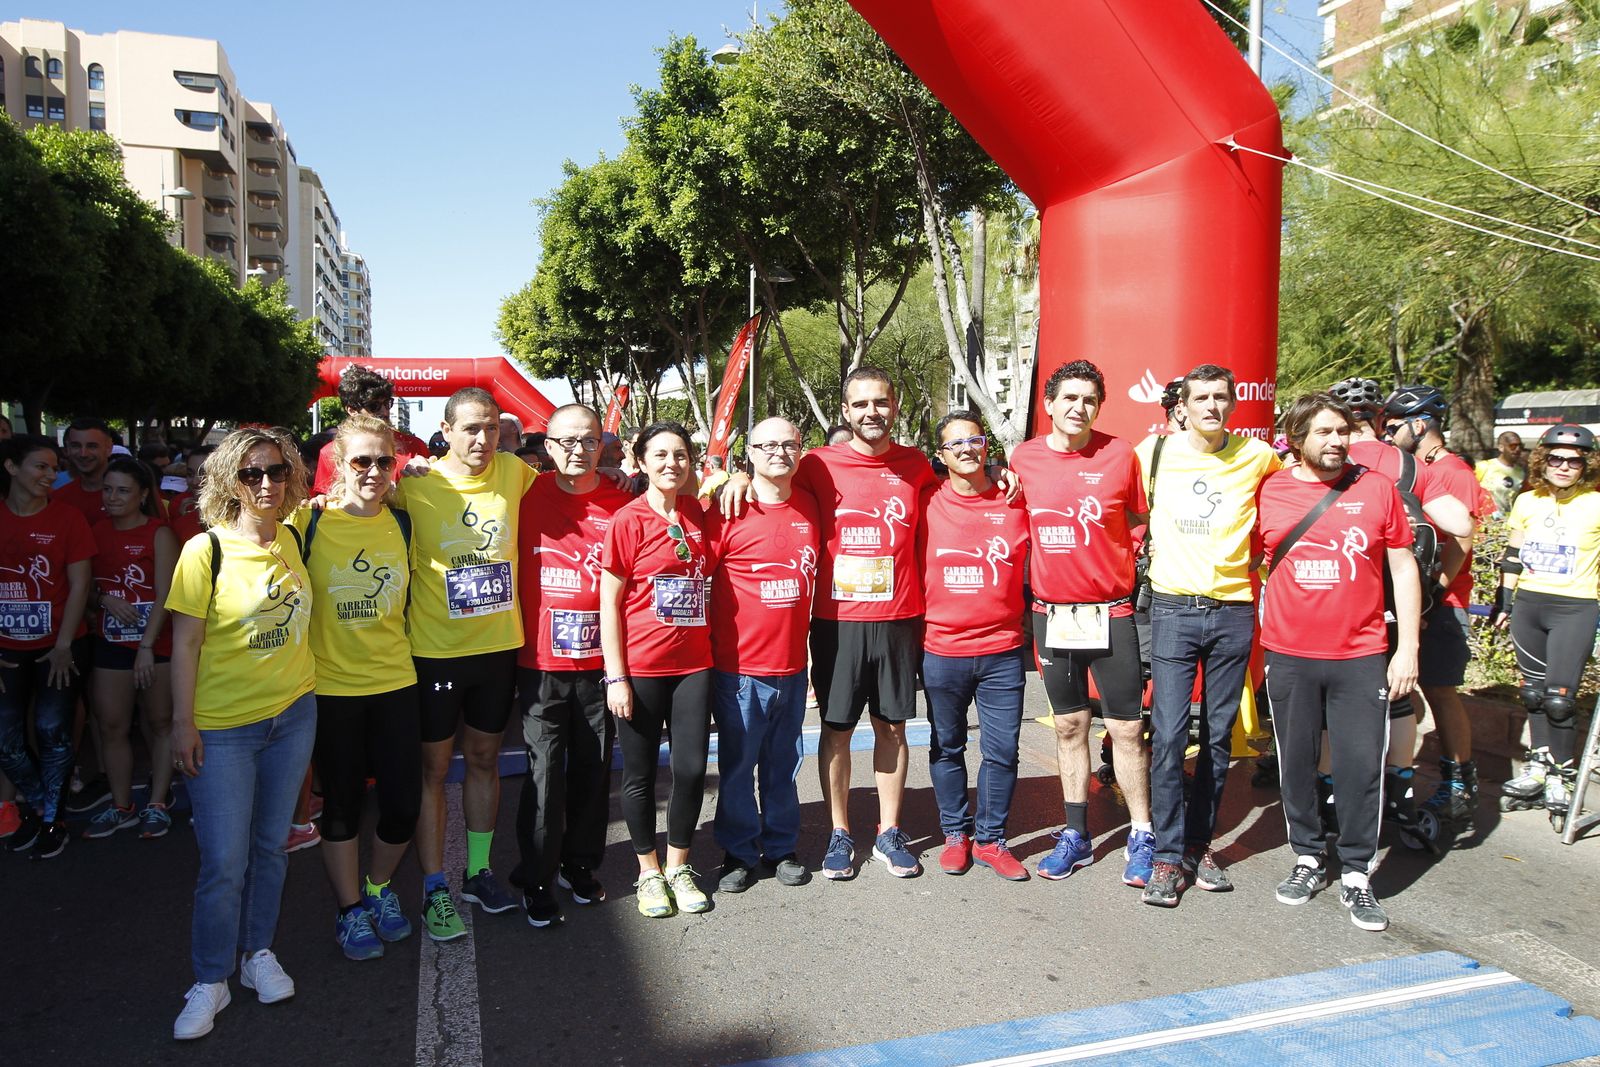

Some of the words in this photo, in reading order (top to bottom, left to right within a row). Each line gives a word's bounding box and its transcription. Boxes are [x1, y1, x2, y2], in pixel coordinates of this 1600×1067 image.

[1234, 427, 1270, 440] correr
[841, 527, 881, 537] CARRERA
[943, 566, 984, 576] CARRERA
[1294, 560, 1340, 570] CARRERA
[541, 566, 581, 580] CARRERA
[840, 570, 885, 585] 285
[453, 578, 504, 600] 2148
[761, 578, 800, 590] CARRERA
[337, 600, 378, 612] CARRERA
[662, 592, 698, 609] 2223
[337, 609, 378, 620] SOLIDARIA
[249, 627, 290, 644] CARRERA
[556, 623, 598, 641] 2107
